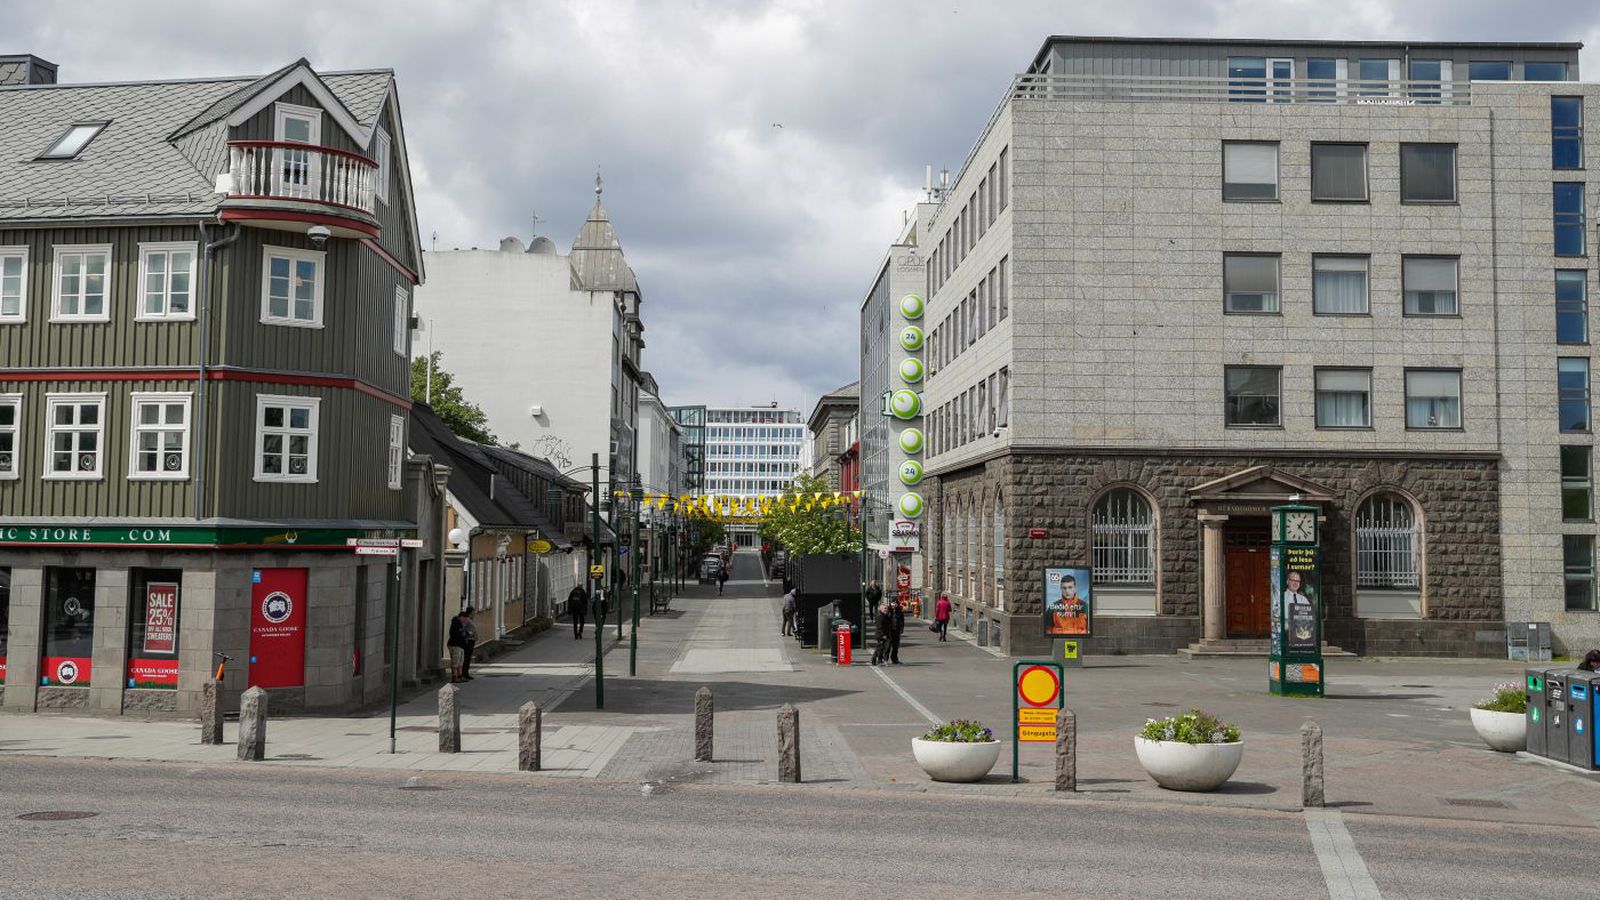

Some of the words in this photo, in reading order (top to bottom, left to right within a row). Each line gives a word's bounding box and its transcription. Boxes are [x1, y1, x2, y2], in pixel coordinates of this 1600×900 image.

[29, 528, 91, 540] STORE
[149, 592, 174, 608] SALE
[148, 608, 173, 626] 25%
[147, 632, 172, 640] SWEATERS
